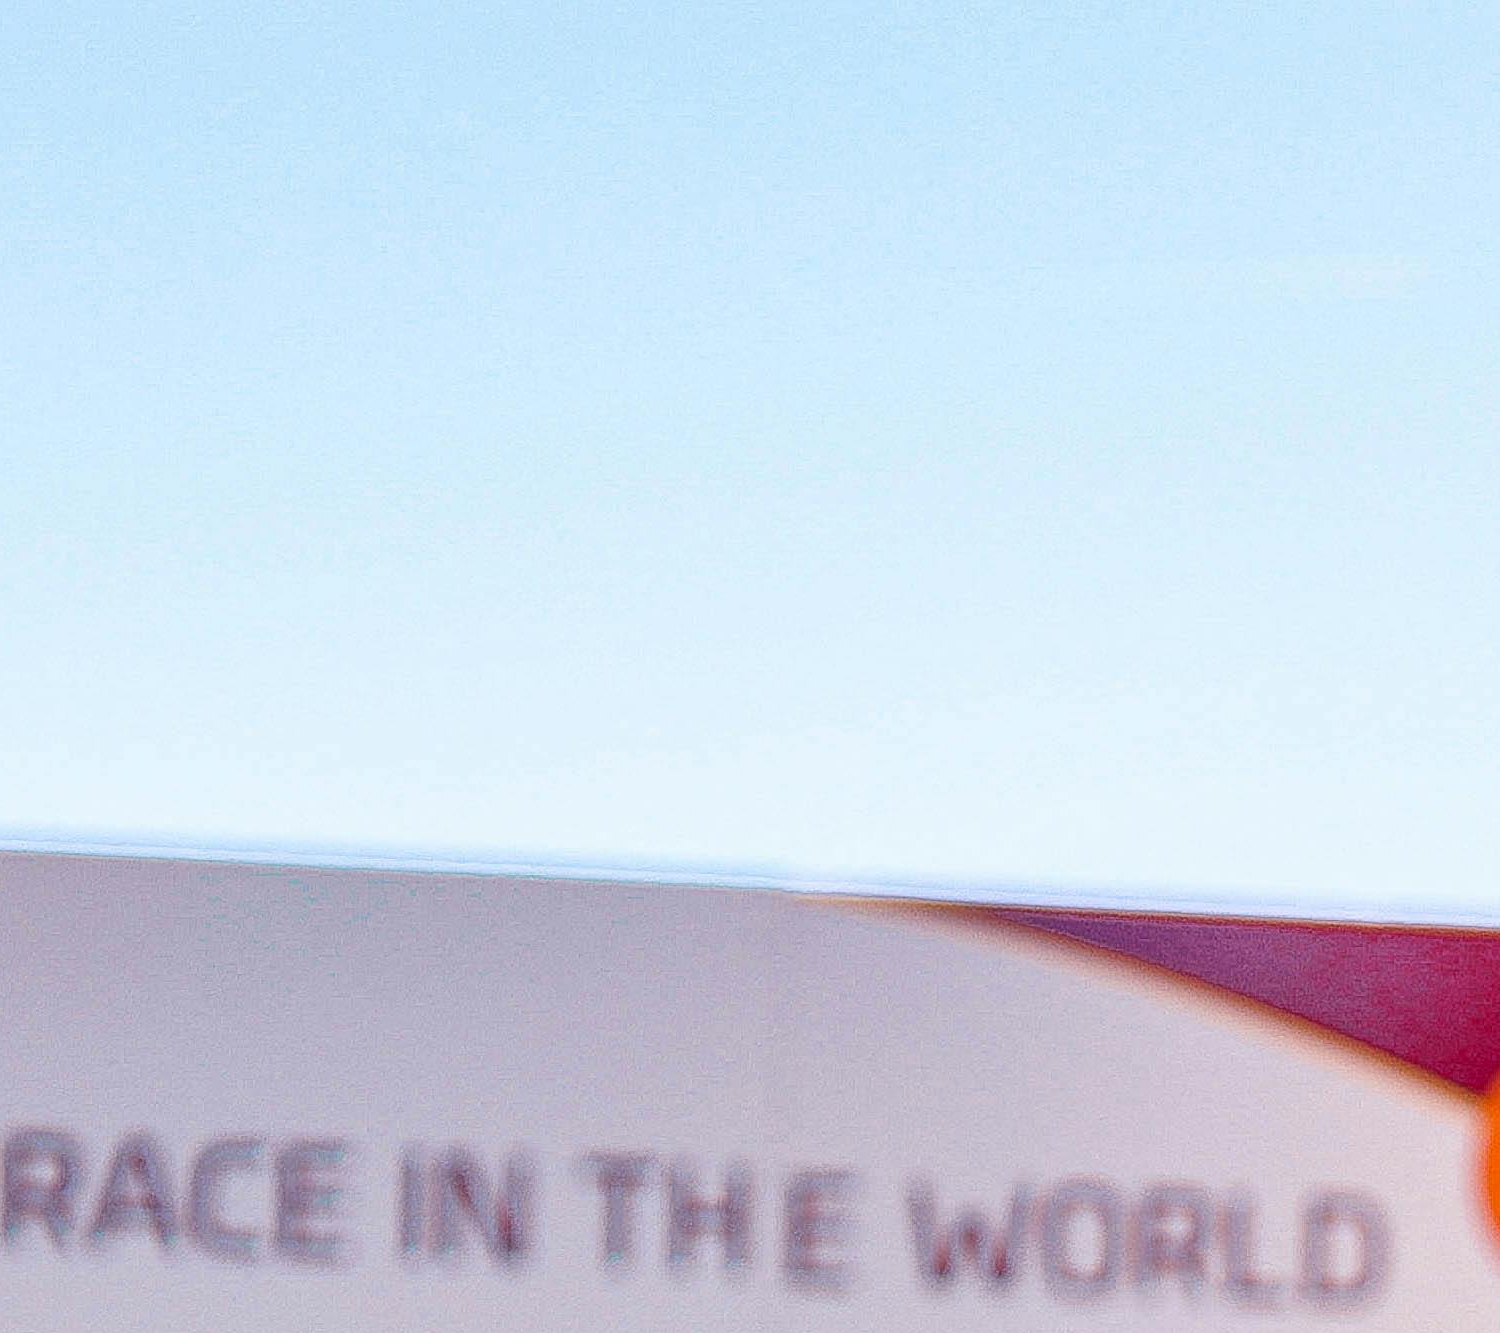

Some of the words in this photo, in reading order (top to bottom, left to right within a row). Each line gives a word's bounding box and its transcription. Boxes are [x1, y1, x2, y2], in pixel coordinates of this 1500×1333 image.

[394, 1140, 534, 1272] IN
[582, 1148, 860, 1296] THE
[898, 1172, 1394, 1314] WORLD
